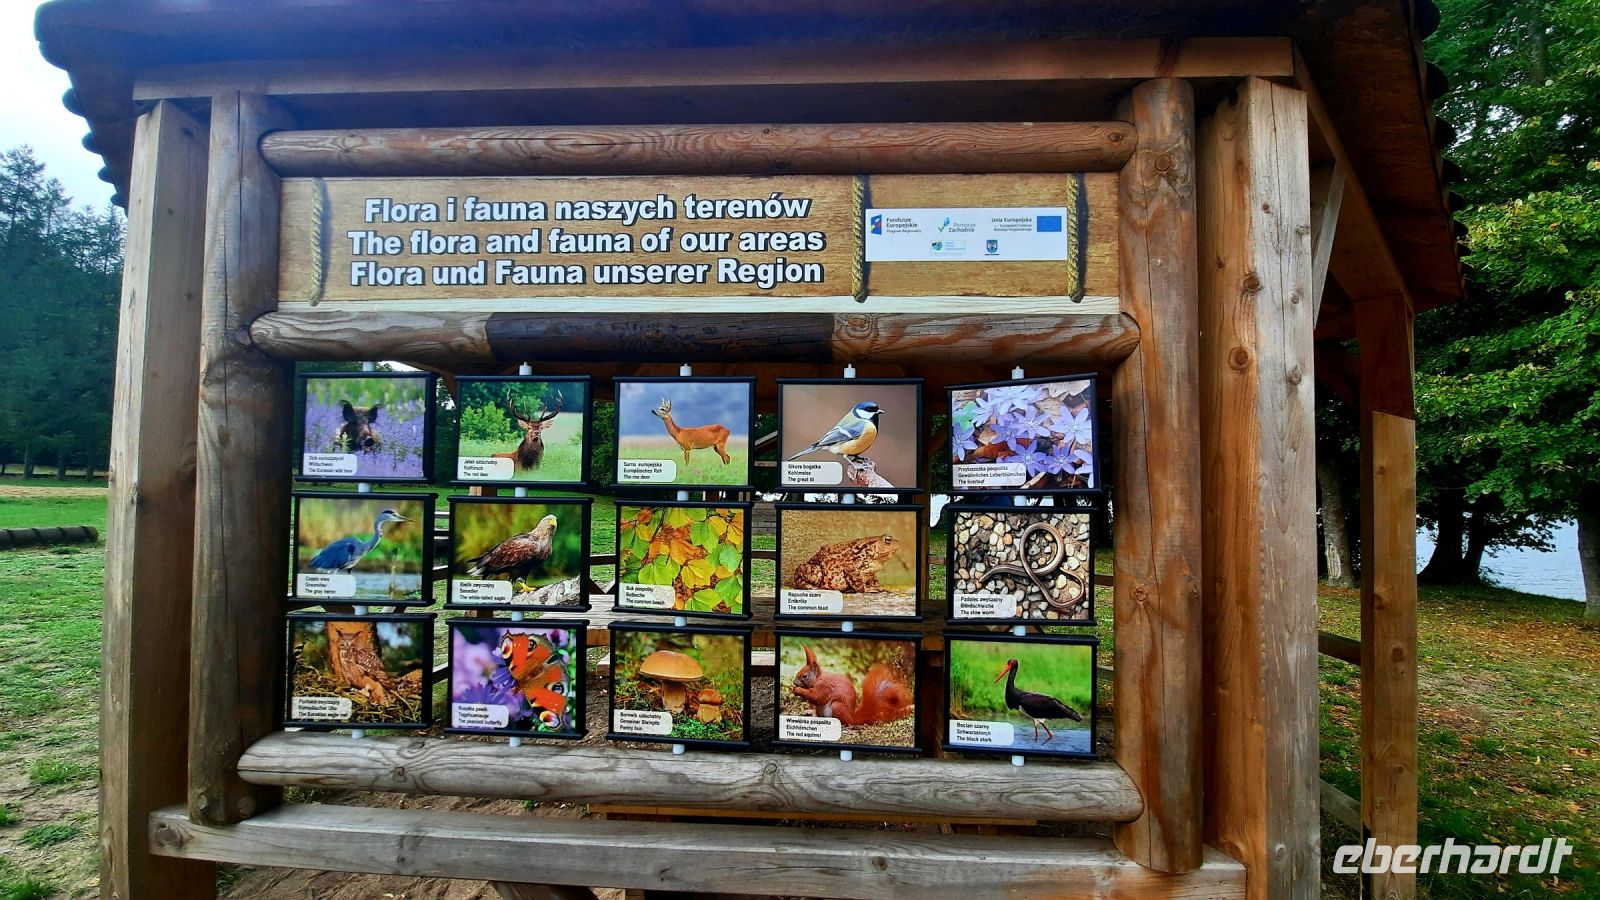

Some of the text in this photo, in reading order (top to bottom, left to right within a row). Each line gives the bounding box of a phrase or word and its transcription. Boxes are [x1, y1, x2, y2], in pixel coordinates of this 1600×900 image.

[365, 192, 812, 226] Flora i fauna naszych terenów
[347, 226, 826, 255] The flora and fauna of our areas
[351, 257, 824, 288] Flora und Fauna unserer Region
